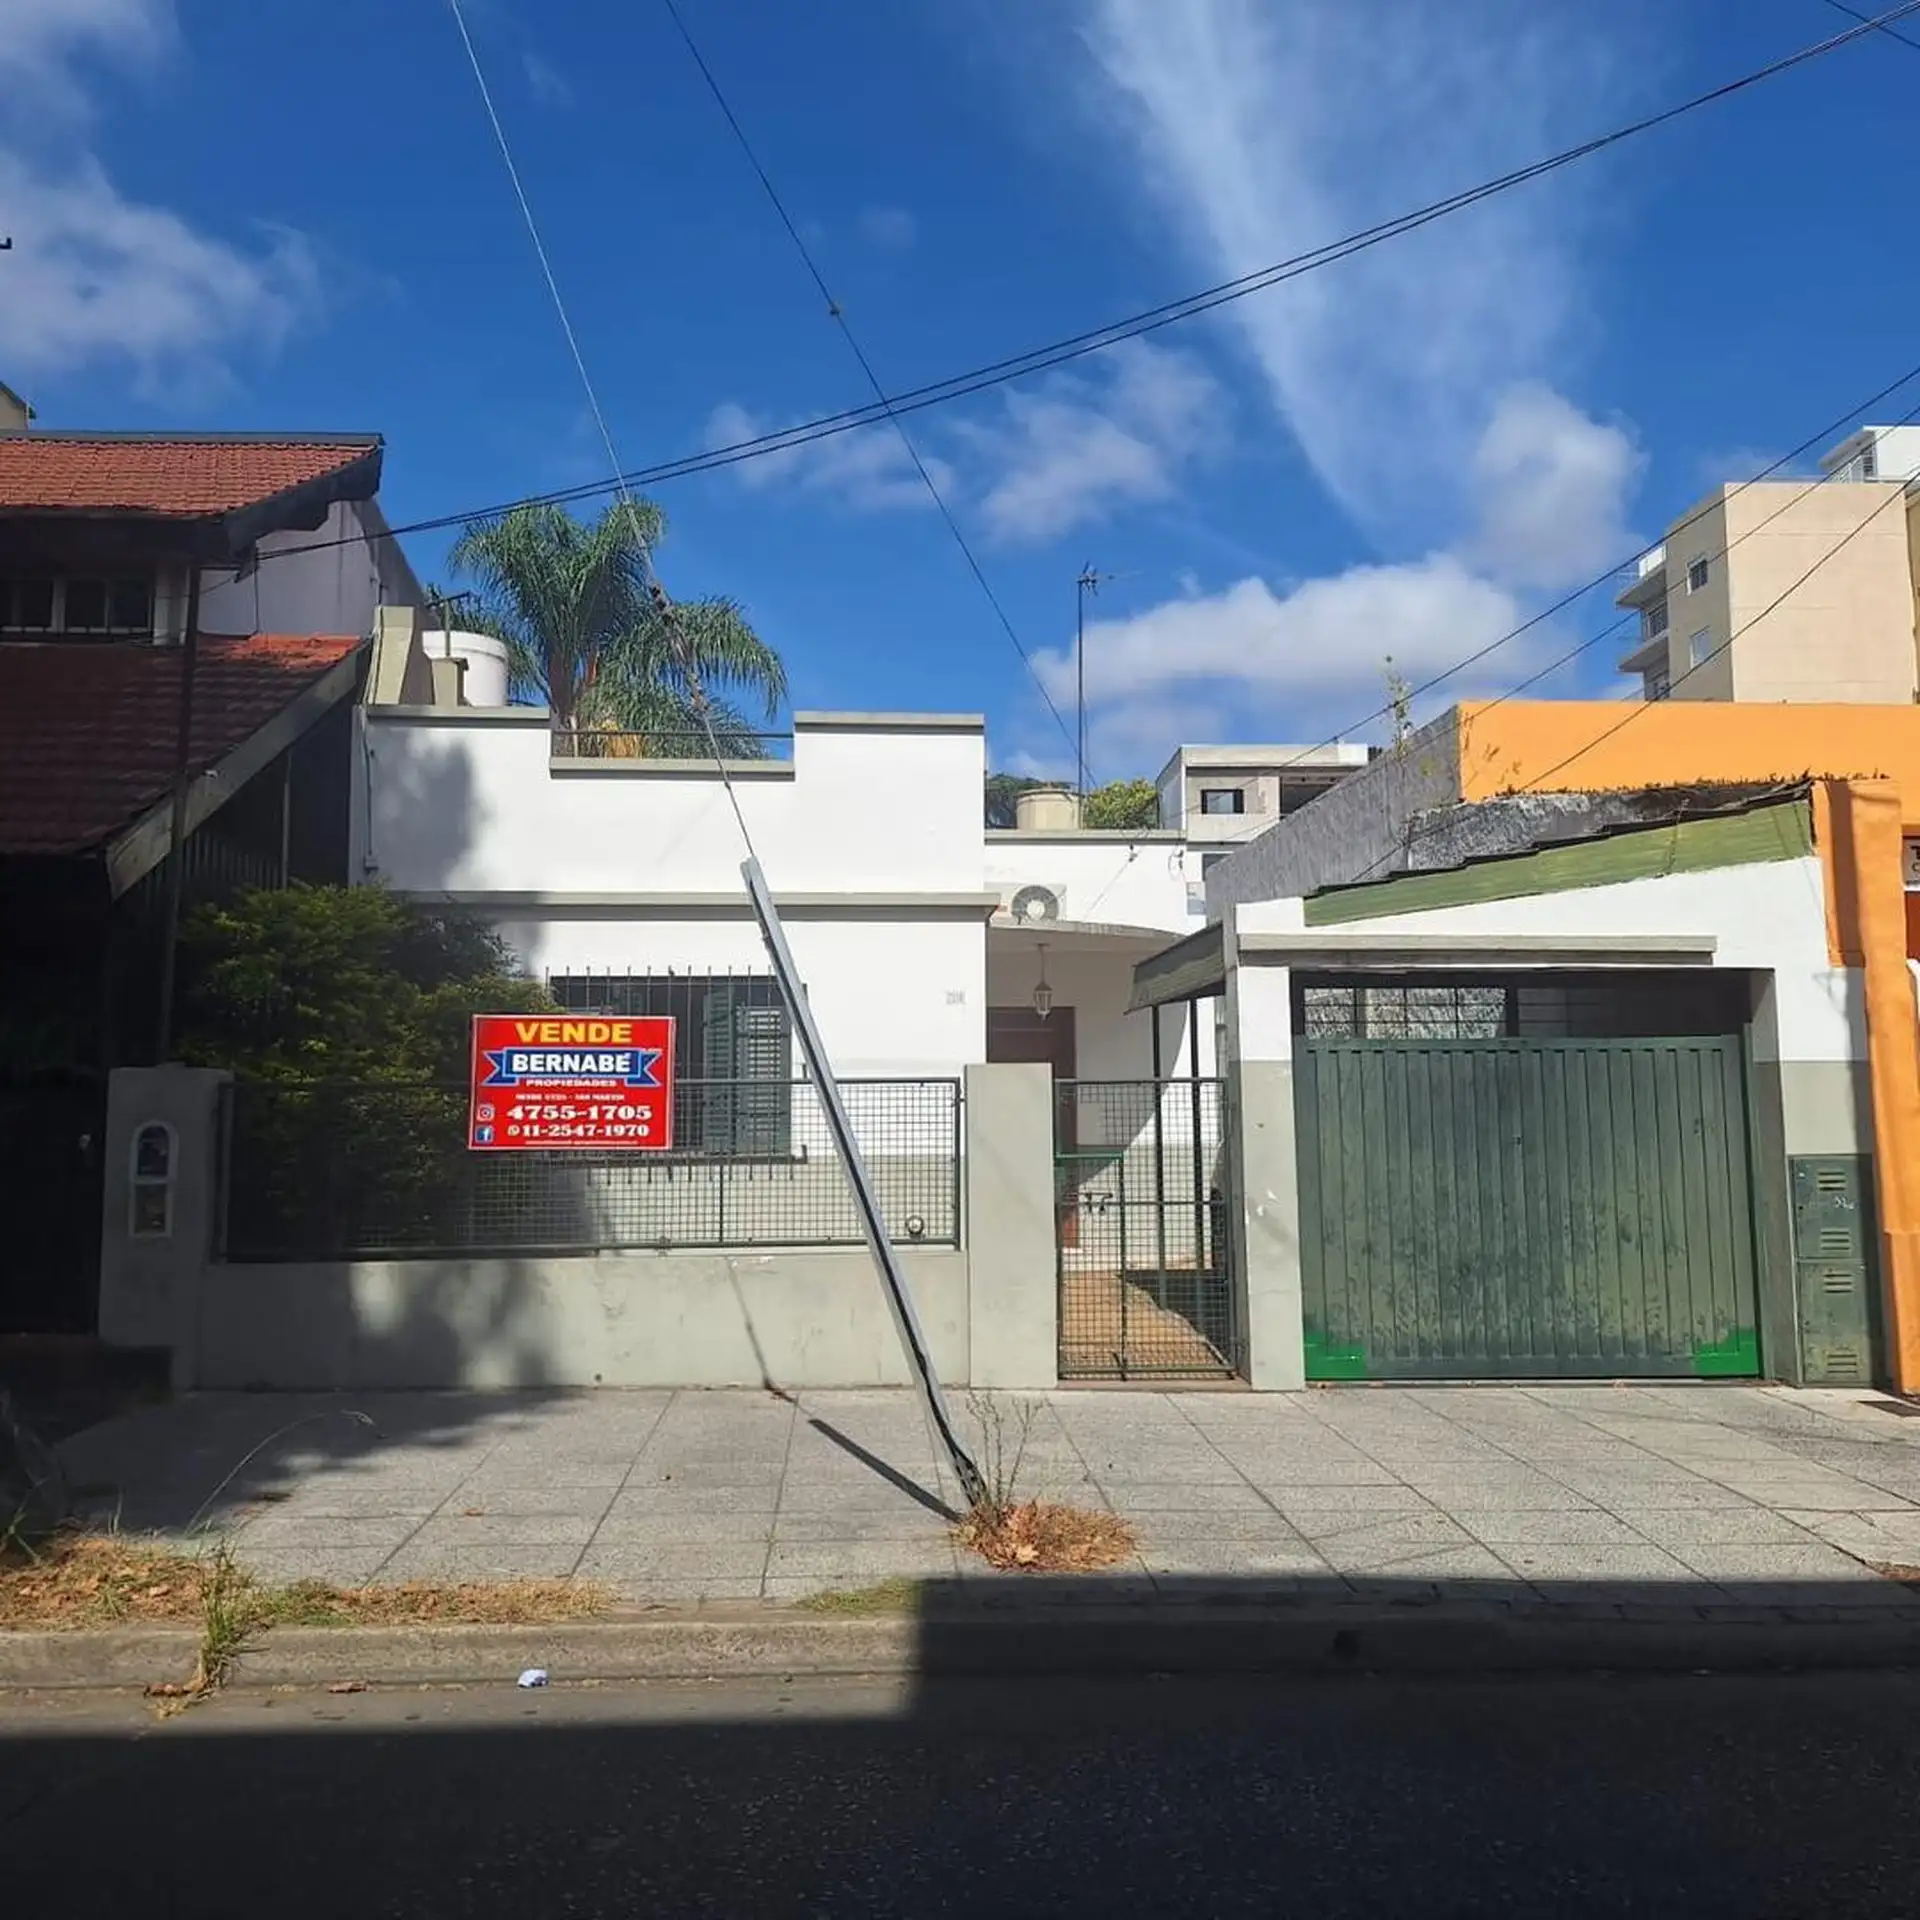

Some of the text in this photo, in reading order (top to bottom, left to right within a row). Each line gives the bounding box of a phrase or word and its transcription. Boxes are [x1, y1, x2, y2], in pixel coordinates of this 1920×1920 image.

[515, 1022, 633, 1043] VENDE
[511, 1052, 631, 1073] BERNABÉ
[525, 1079, 617, 1087] PROPIEDADES
[506, 1104, 653, 1120] 4755-1705
[522, 1124, 650, 1137] 11-2547-1970
